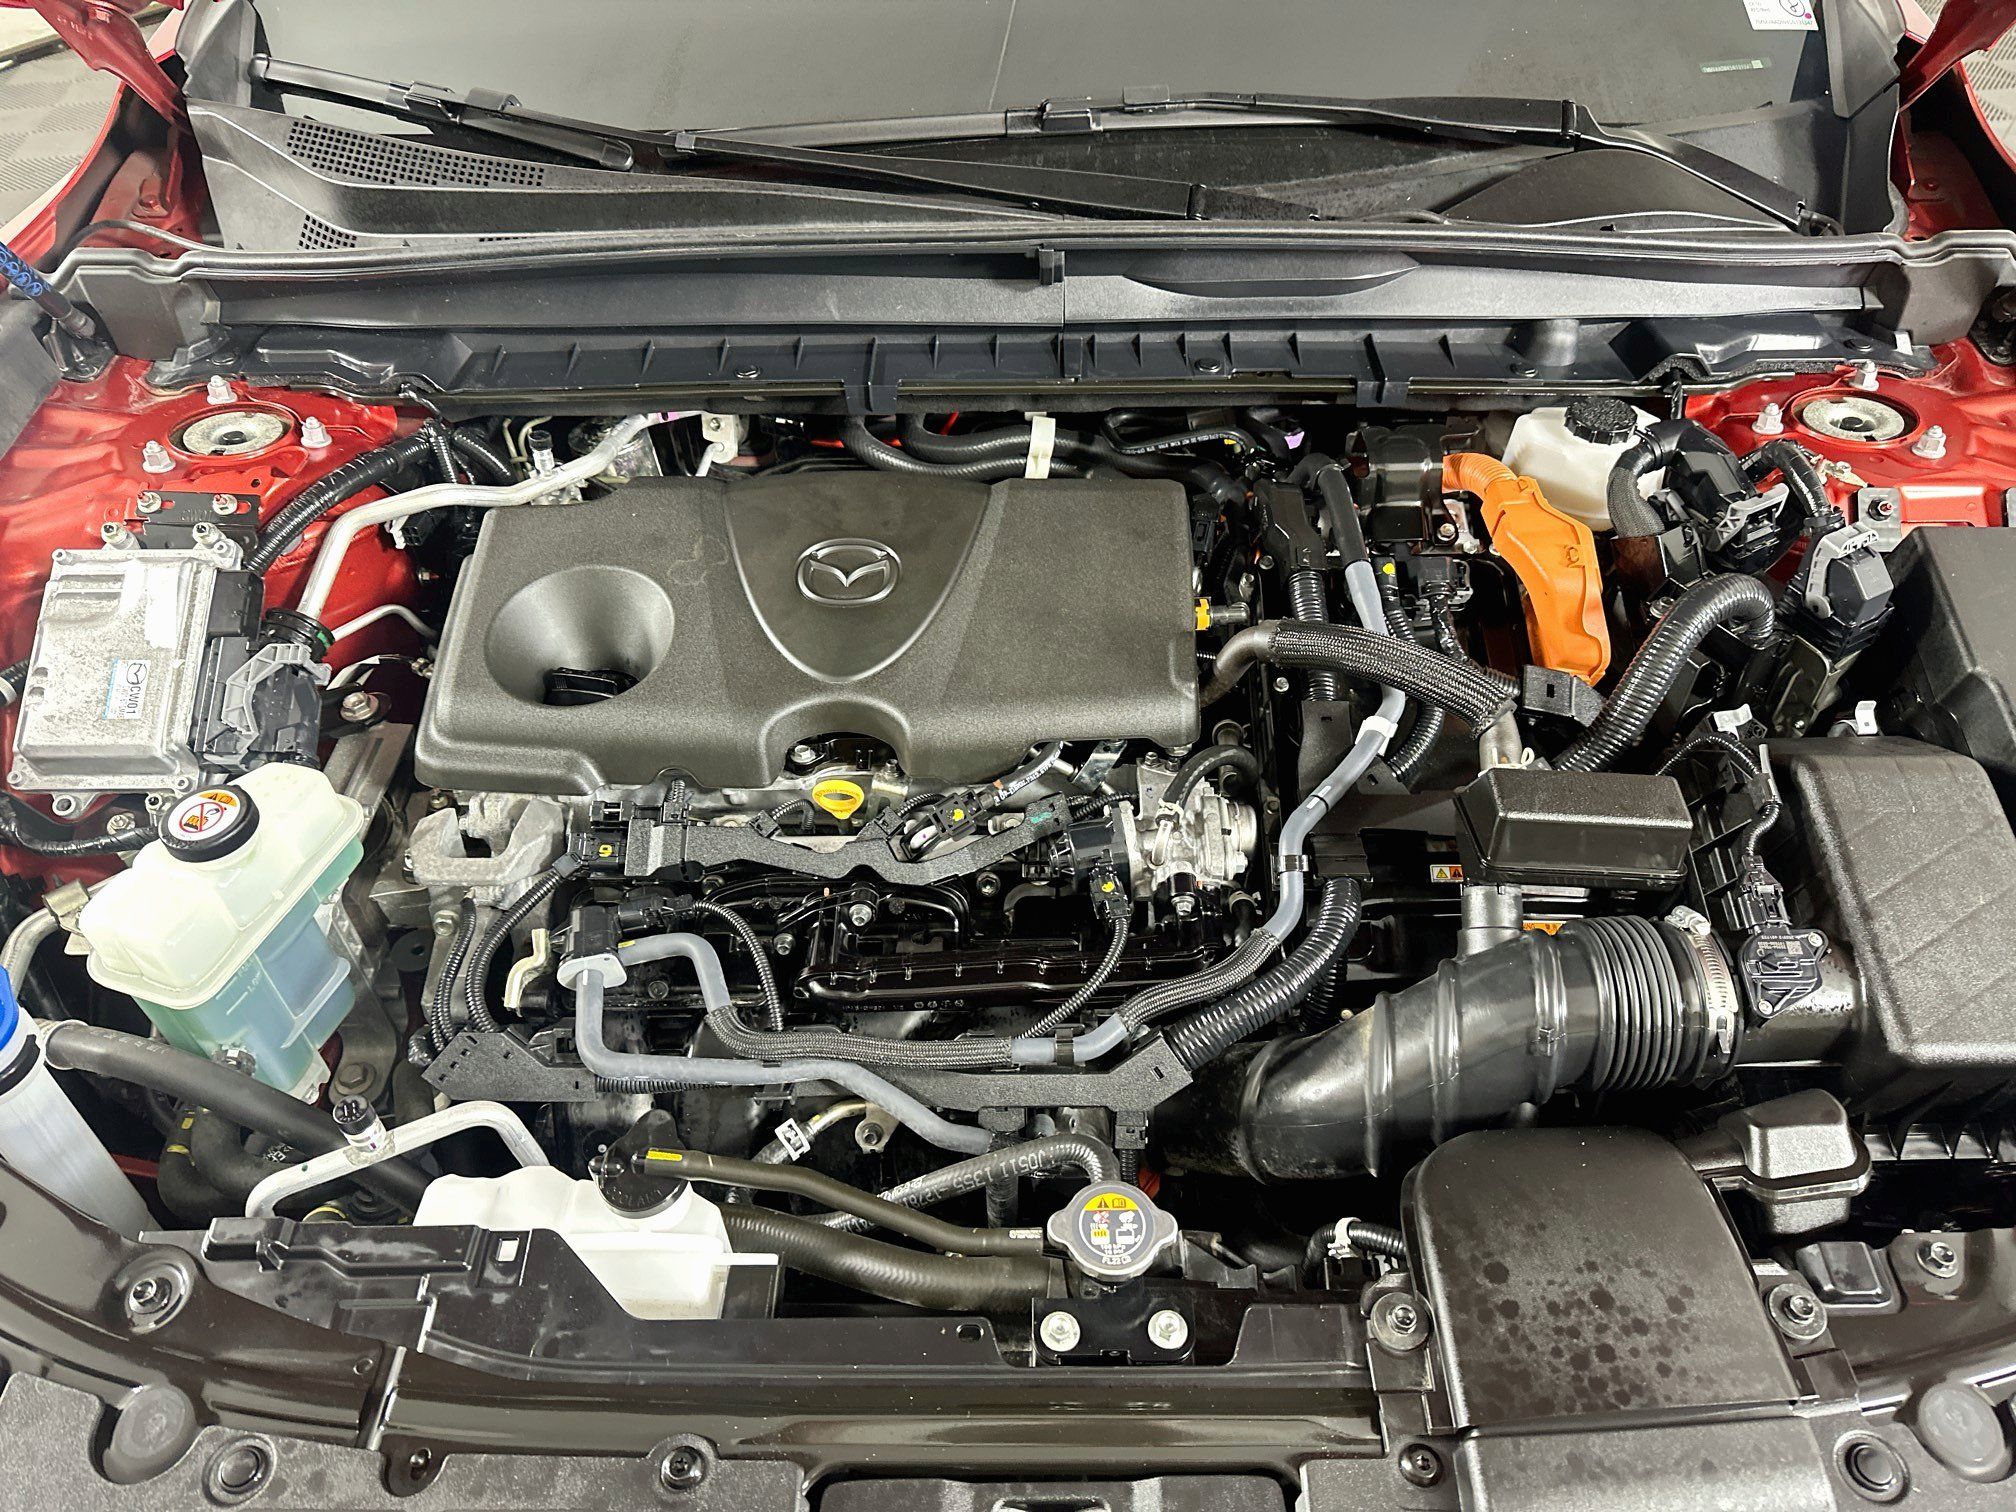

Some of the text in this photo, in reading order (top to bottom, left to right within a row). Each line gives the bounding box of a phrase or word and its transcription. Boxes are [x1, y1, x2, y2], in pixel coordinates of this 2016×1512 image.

[126, 686, 141, 714] CW01
[1000, 1149, 1045, 1178] J0511
[952, 1166, 994, 1192] 1355
